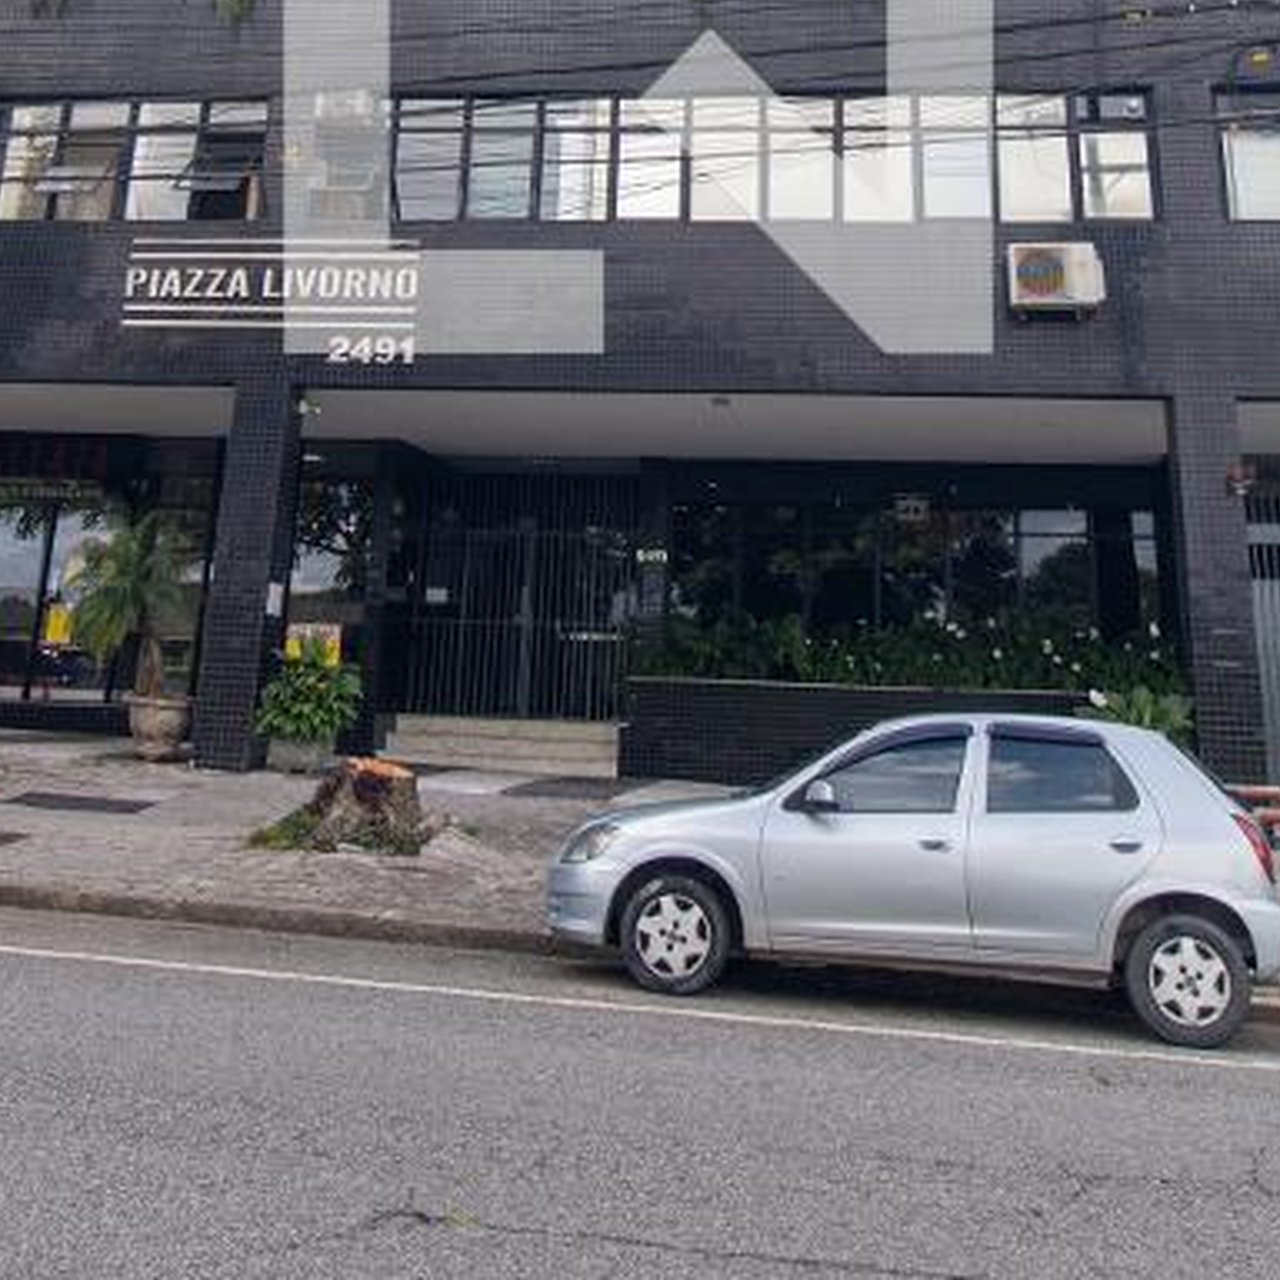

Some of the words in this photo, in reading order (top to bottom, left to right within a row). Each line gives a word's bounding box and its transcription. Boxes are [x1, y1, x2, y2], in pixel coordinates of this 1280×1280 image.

[126, 268, 249, 297] PIAZZA
[262, 269, 417, 298] LIVORNO
[325, 336, 416, 364] 2491
